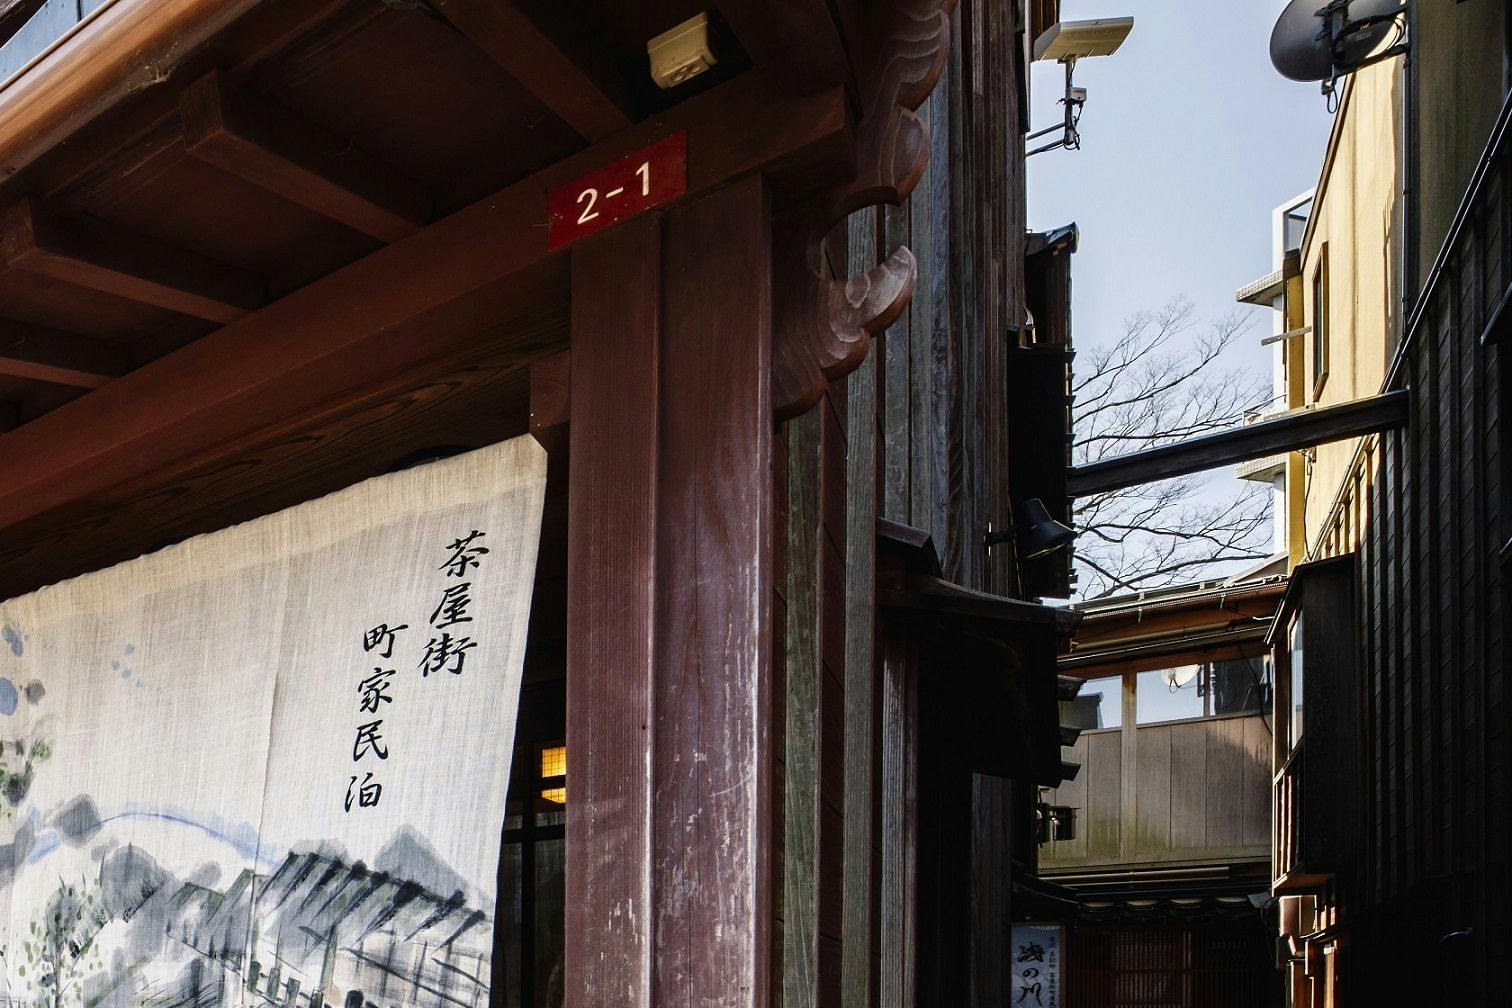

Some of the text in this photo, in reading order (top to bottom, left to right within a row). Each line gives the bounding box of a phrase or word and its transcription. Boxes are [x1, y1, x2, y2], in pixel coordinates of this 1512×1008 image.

[576, 161, 650, 225] 2-1
[417, 529, 490, 678] 茶屋街
[343, 623, 409, 813] 町家民泊
